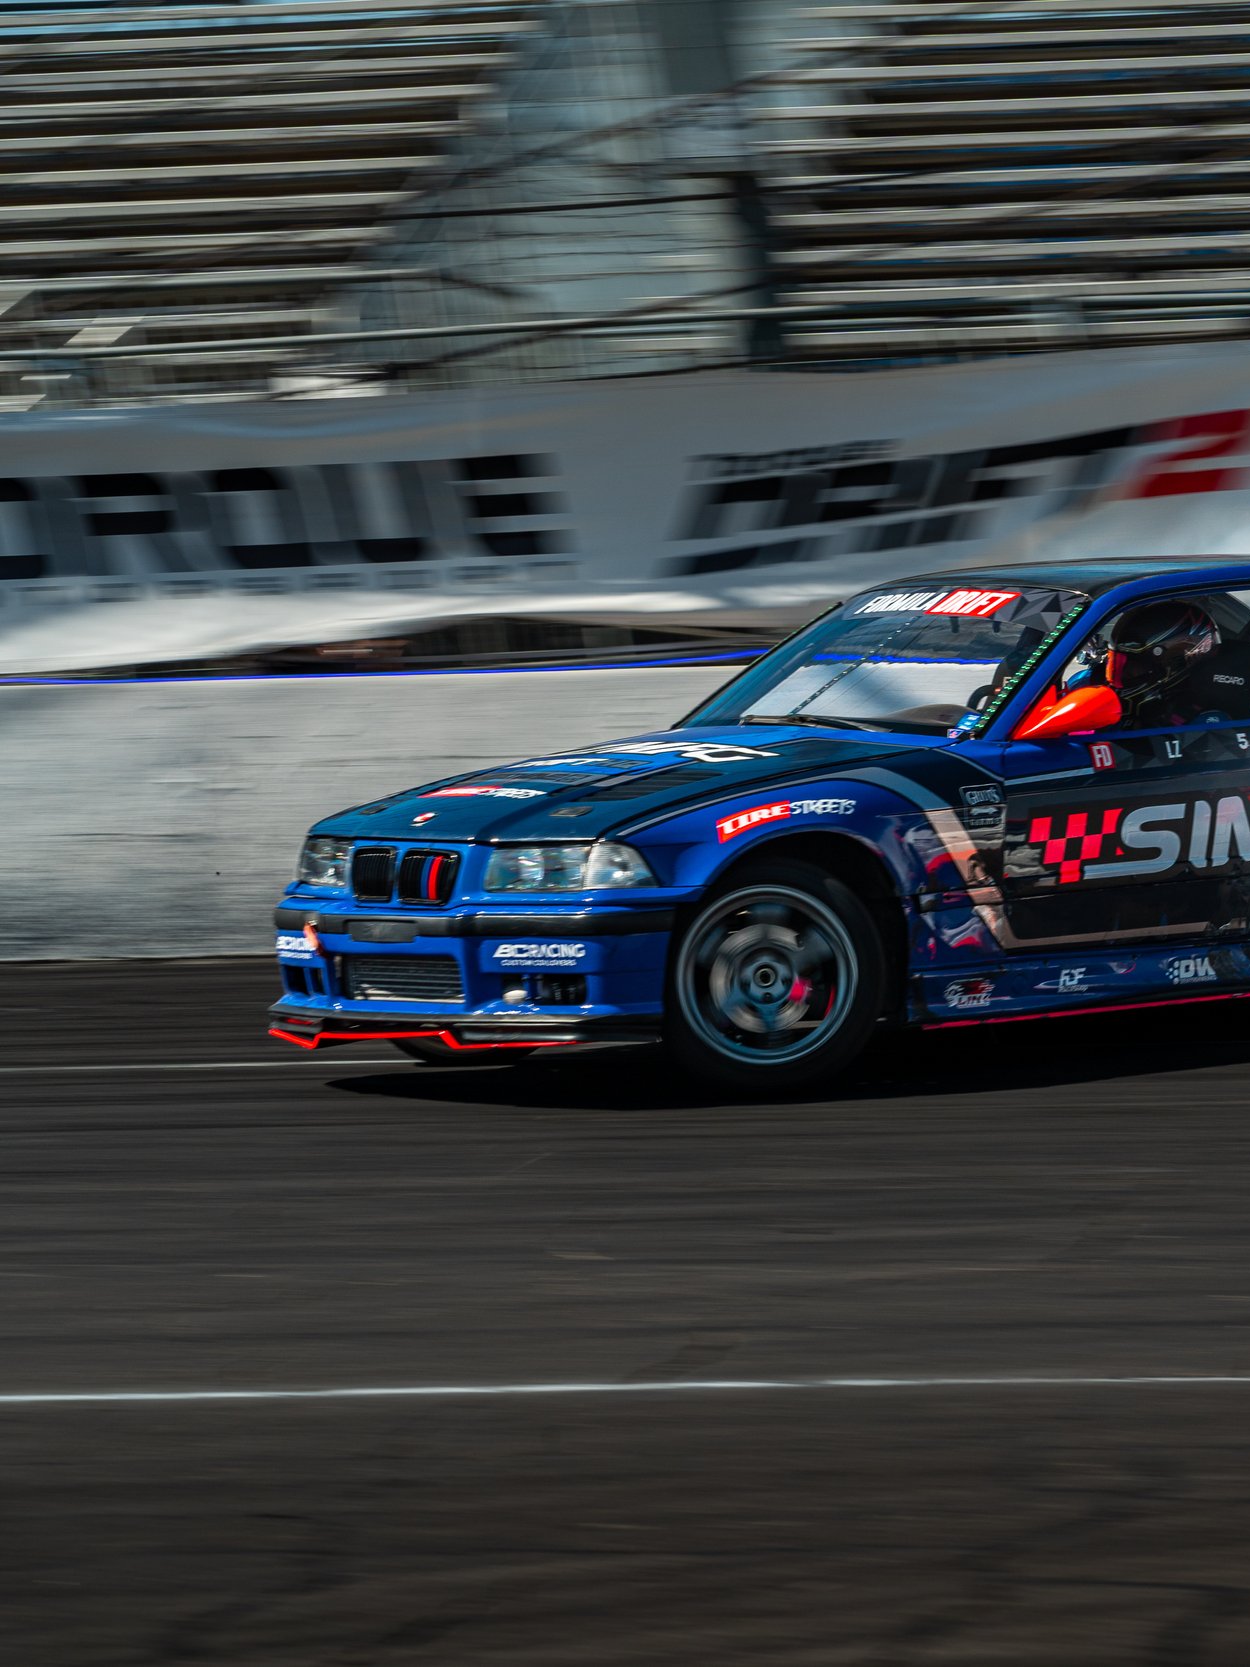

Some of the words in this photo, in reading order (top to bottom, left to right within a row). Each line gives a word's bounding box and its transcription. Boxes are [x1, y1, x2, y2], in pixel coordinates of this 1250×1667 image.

[854, 592, 948, 615] FORMULA
[930, 590, 1016, 615] DRIFT
[1213, 674, 1245, 686] RECARO
[1165, 740, 1183, 758] LZ
[1236, 733, 1249, 750] 5
[1092, 744, 1113, 768] FD
[717, 803, 791, 834] TIRE
[789, 799, 857, 815] STREETS
